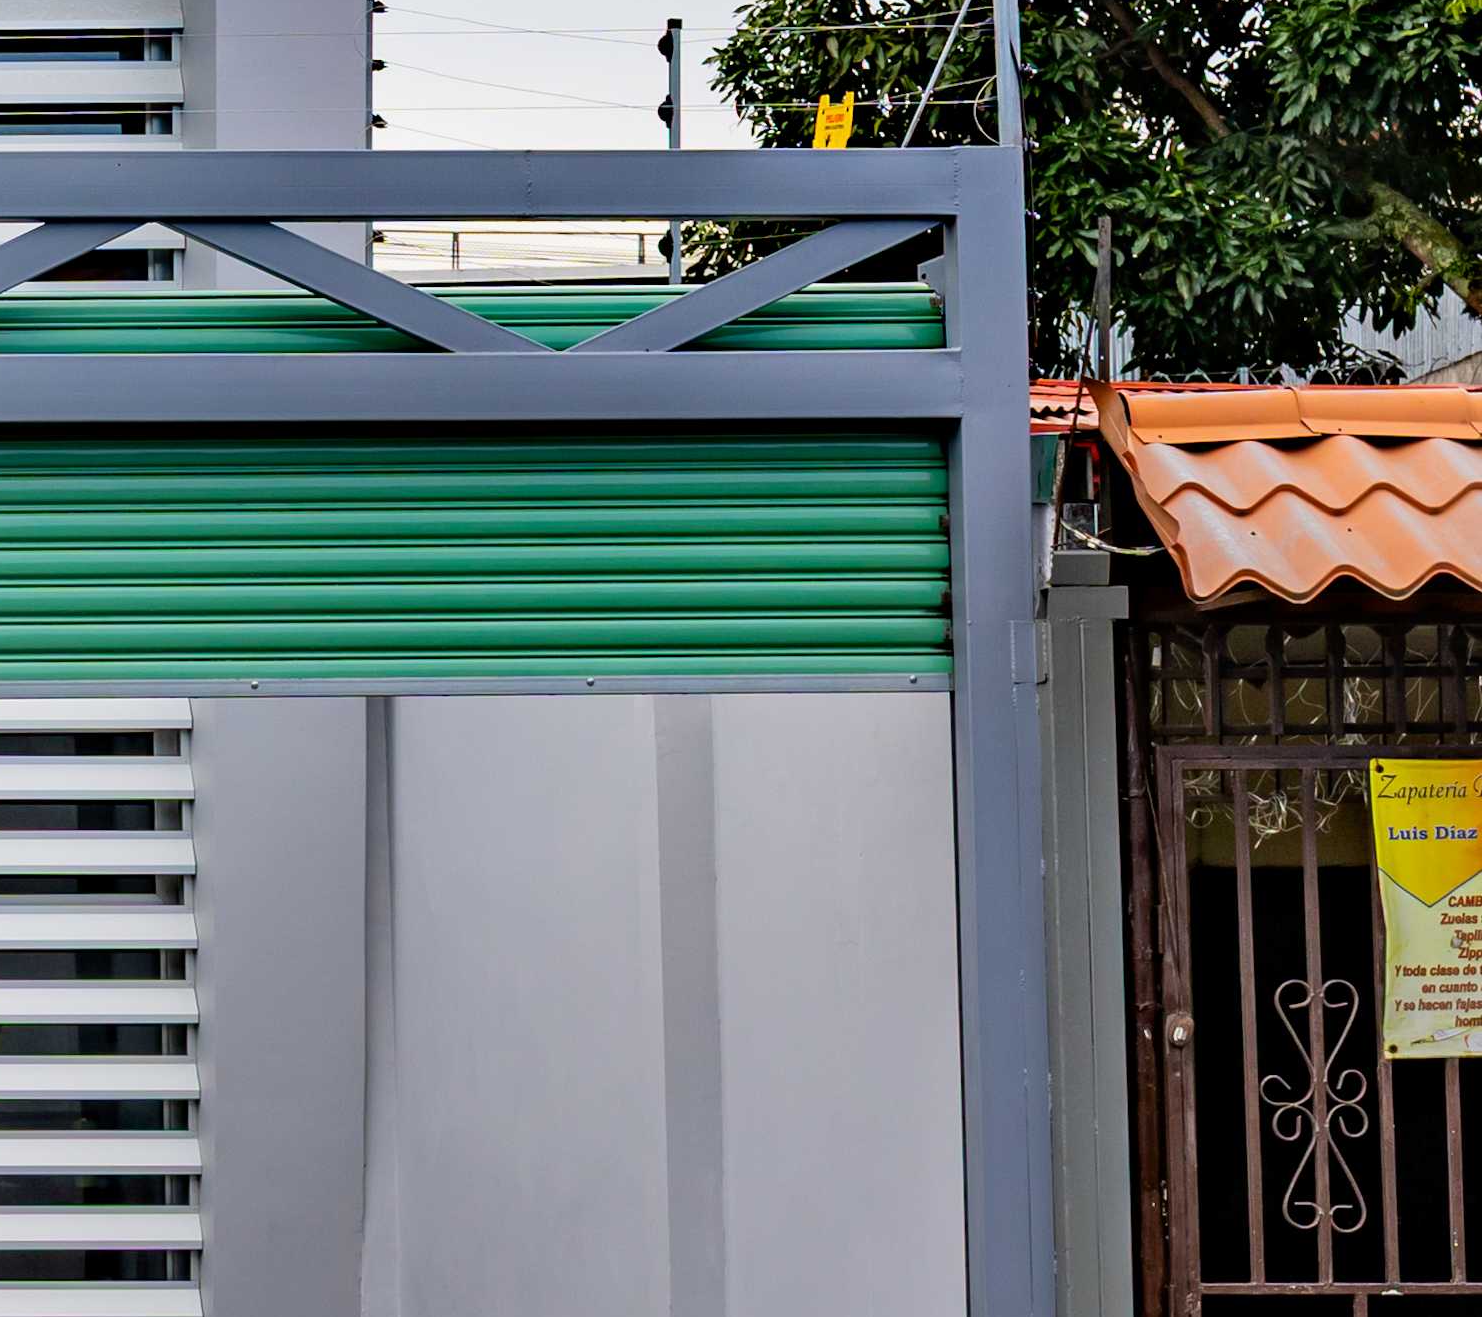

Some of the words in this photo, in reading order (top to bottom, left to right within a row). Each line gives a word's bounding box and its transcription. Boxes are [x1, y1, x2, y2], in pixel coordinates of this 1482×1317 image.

[1377, 774, 1467, 805] Zapatería
[1387, 826, 1428, 840] Luis
[1395, 965, 1402, 977] Y
[1403, 965, 1427, 976] toda
[1429, 964, 1460, 976] clase
[1463, 964, 1477, 975] de
[1421, 984, 1436, 993] en
[1439, 981, 1478, 993] cuanto
[1395, 999, 1402, 1011] Y
[1403, 1002, 1416, 1011] se
[1418, 998, 1452, 1011] hacen
